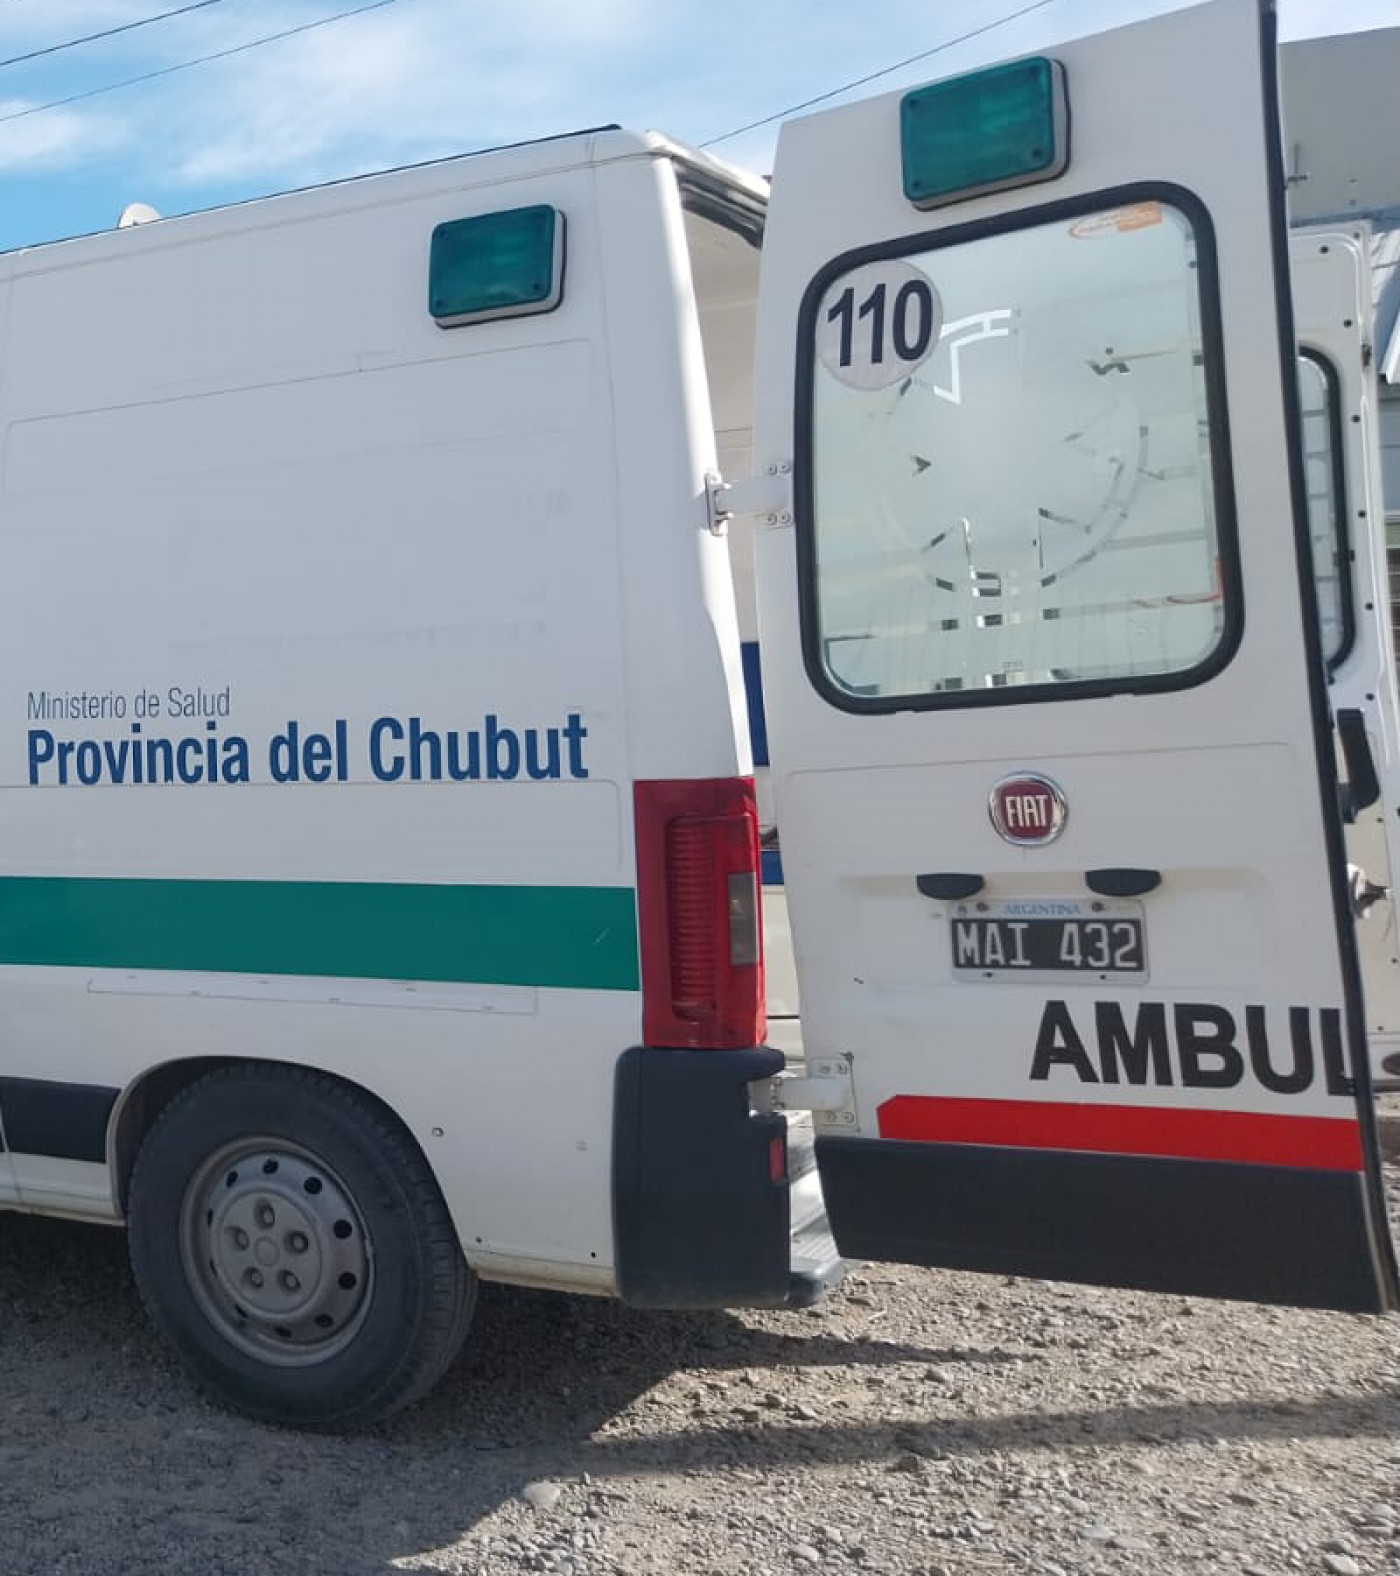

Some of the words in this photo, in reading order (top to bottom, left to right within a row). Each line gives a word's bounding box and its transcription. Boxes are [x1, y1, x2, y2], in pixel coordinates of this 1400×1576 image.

[828, 280, 933, 367] 110
[27, 689, 127, 720] Ministerio
[134, 690, 162, 717] de
[167, 686, 231, 717] Salud
[28, 721, 249, 785] Provincia
[269, 720, 347, 782] del
[369, 713, 588, 781] Chubut
[1005, 795, 1048, 828] FIAT
[1003, 903, 1081, 915] ARGENTINA
[957, 923, 1031, 966] MAI
[1059, 922, 1138, 968] 432
